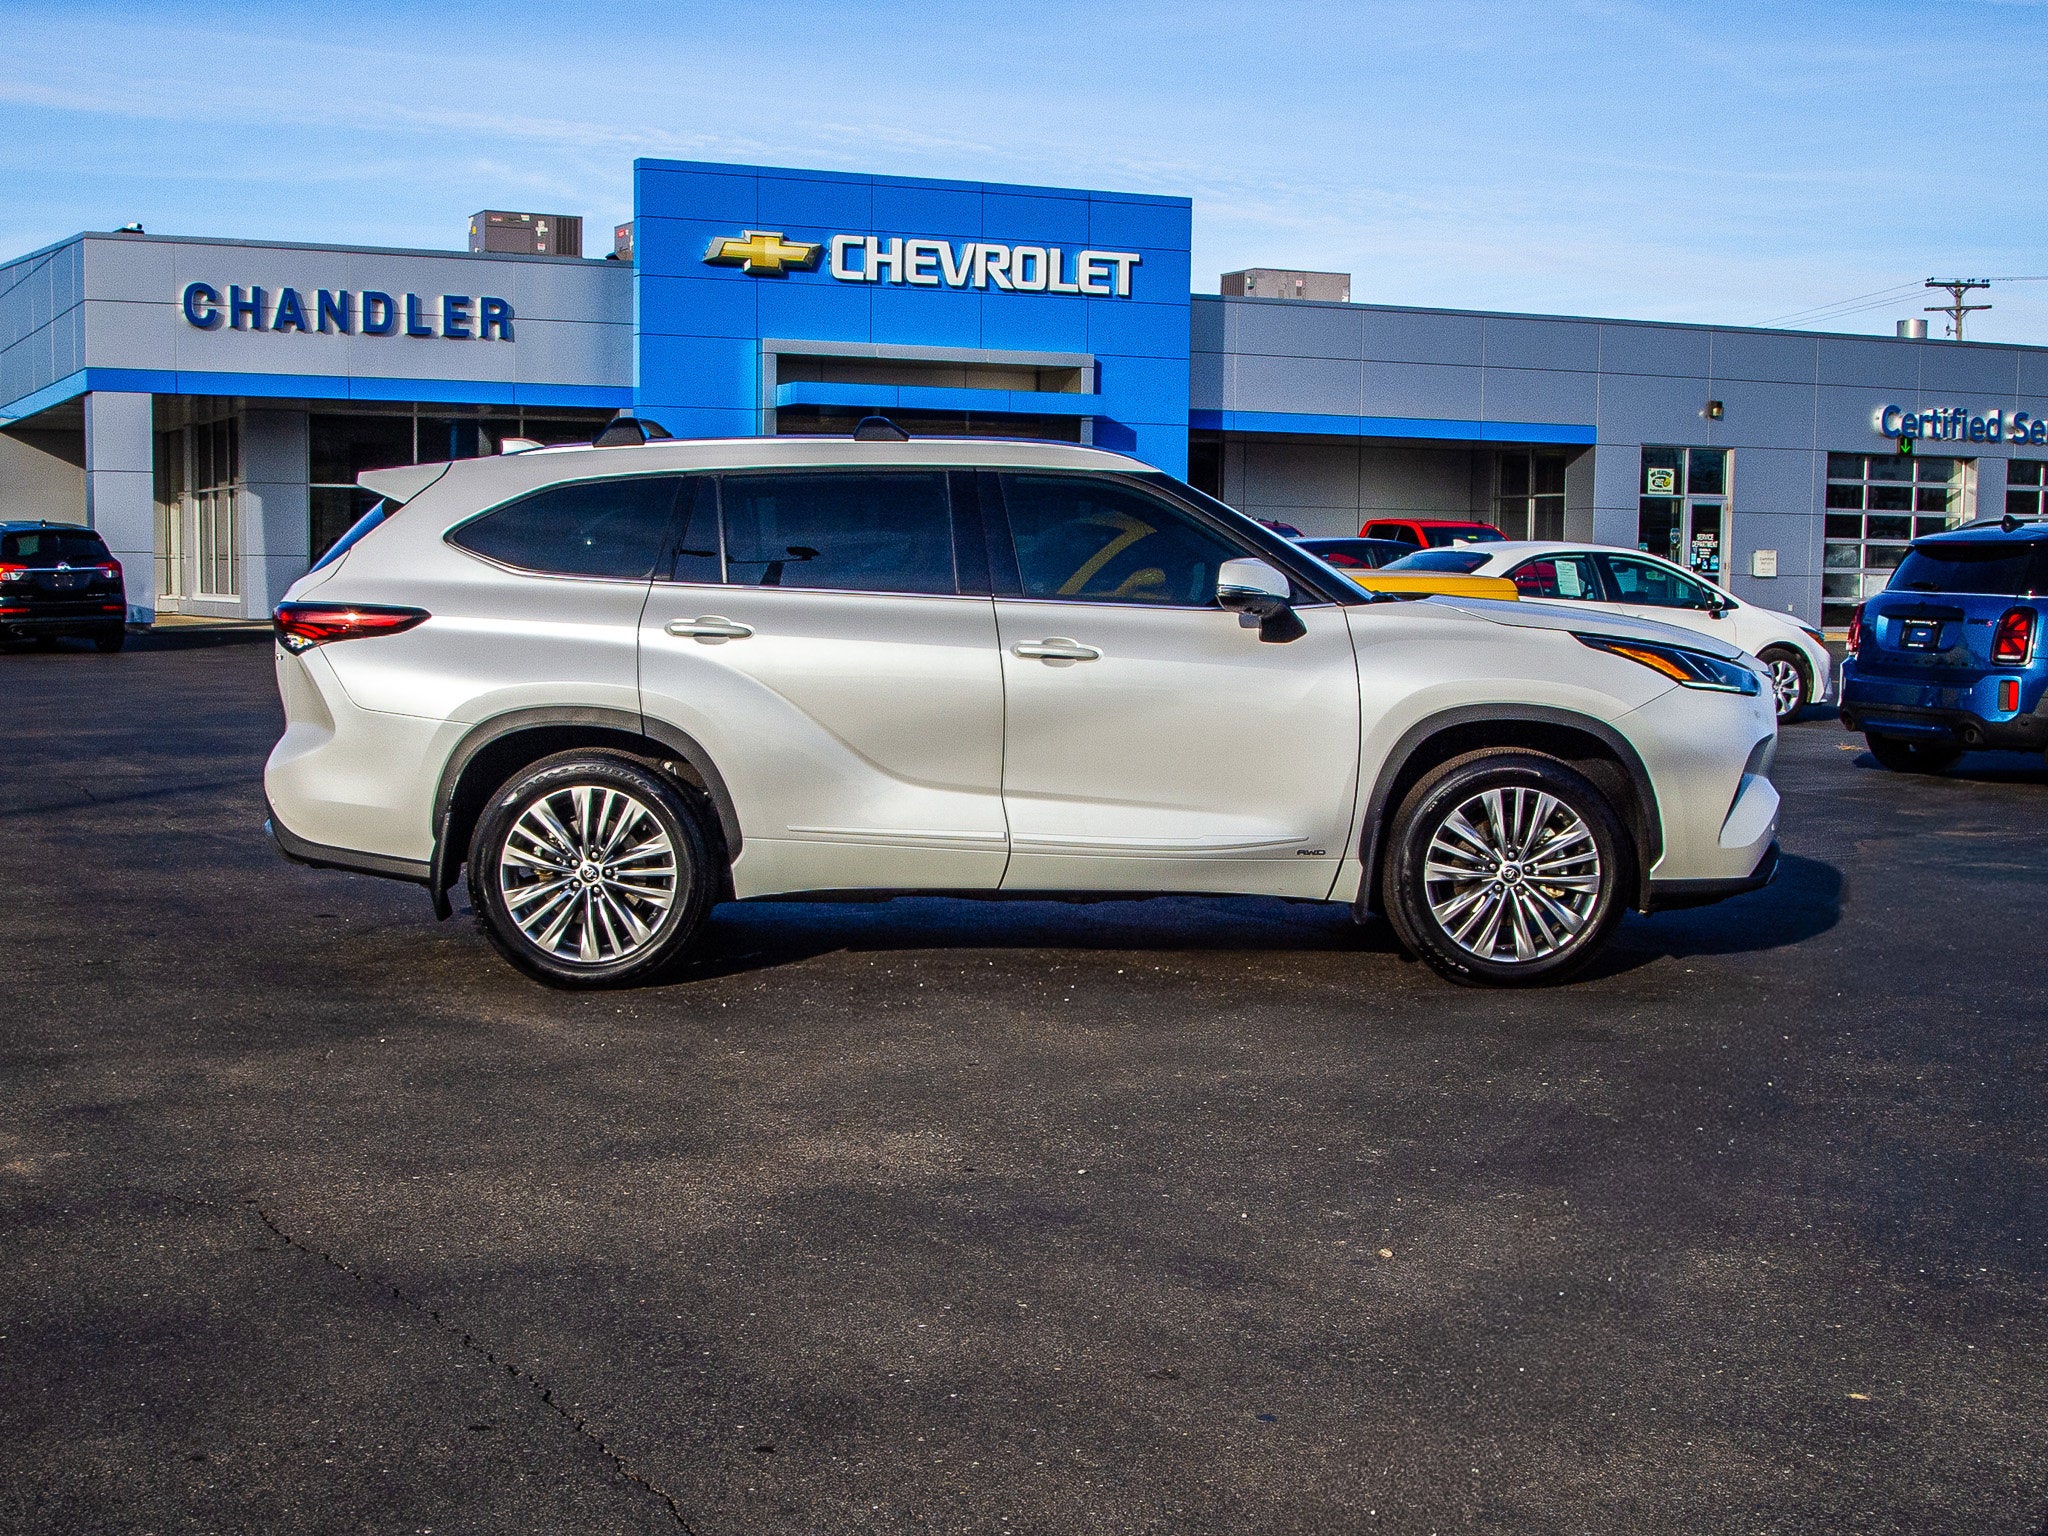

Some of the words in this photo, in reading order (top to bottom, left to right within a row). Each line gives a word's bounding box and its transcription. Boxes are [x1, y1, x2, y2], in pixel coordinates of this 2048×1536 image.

[829, 233, 1141, 296] CHEVROLET
[182, 281, 512, 339] CHANDLER
[1881, 404, 2003, 443] Certified
[2013, 411, 2048, 445] Se
[1691, 540, 1718, 548] DEPARTMENT
